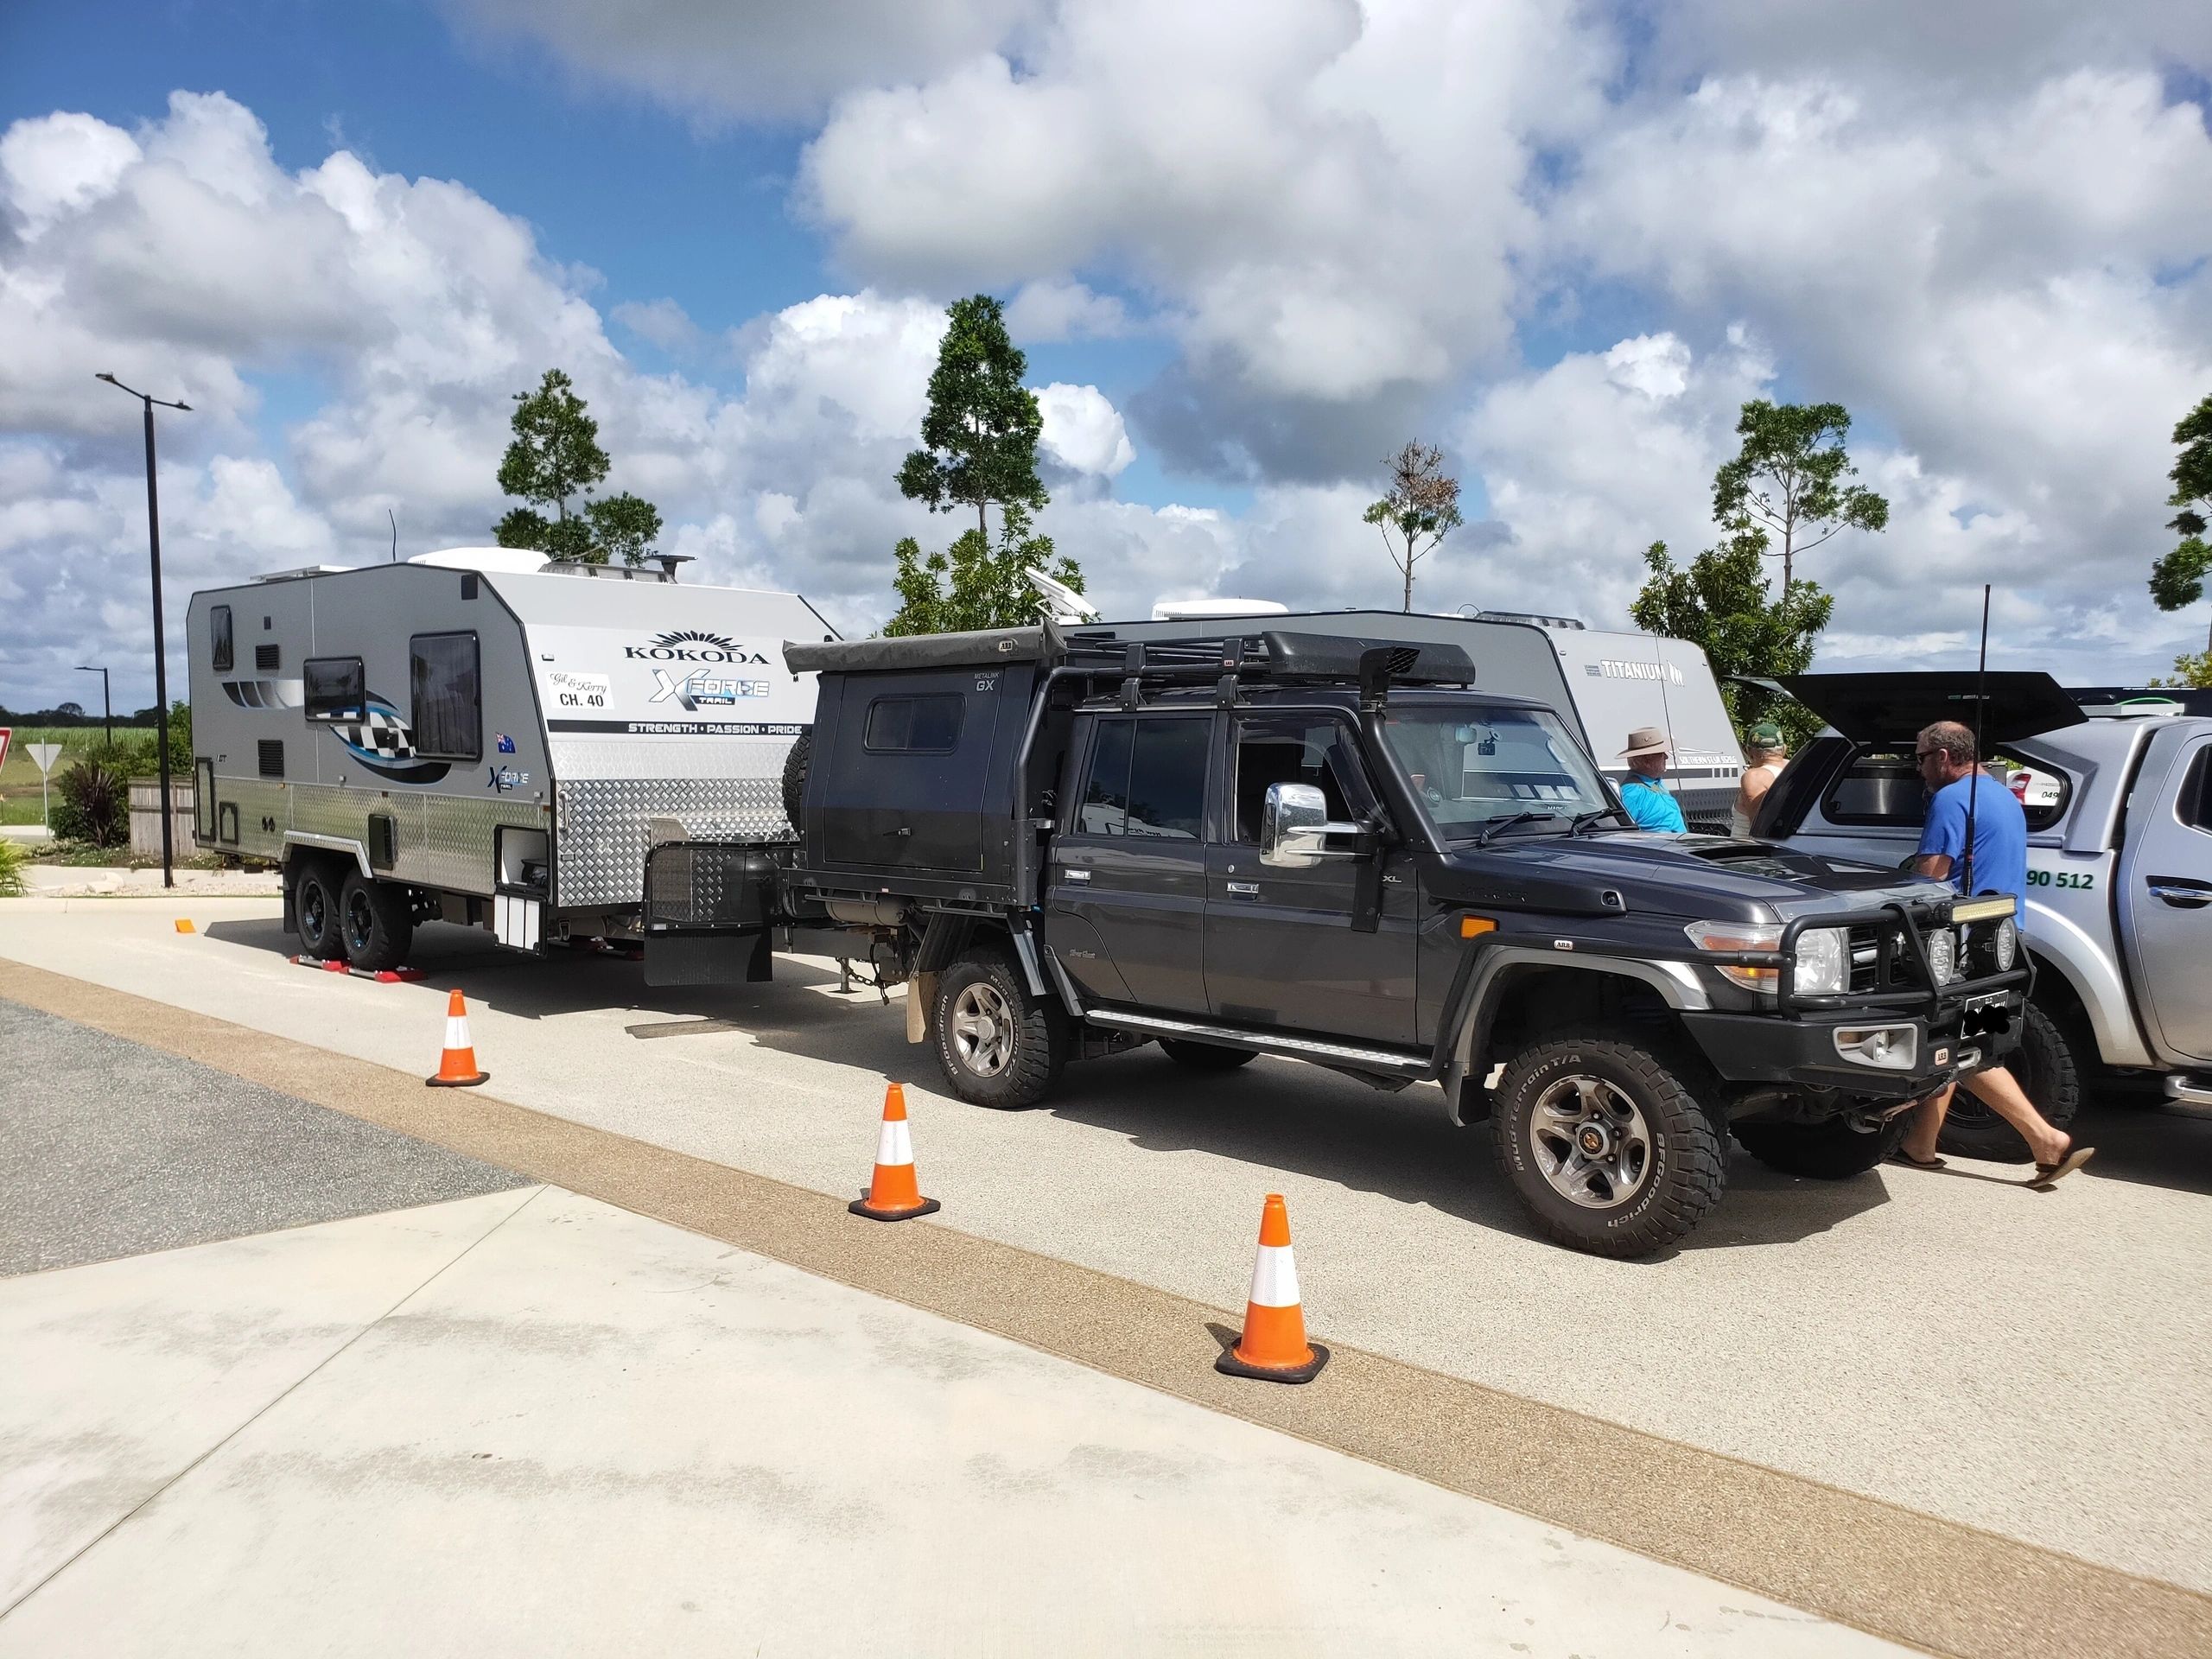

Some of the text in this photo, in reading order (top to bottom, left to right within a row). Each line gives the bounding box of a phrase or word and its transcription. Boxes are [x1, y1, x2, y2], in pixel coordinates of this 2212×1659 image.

[622, 646, 772, 665] KOKODA
[974, 671, 1000, 680] METALINK
[1600, 659, 1667, 682] TITANIUM
[550, 672, 607, 695] Gil & Kerry
[976, 679, 995, 691] GX
[559, 693, 605, 708] CH. 40
[698, 696, 733, 705] TRAIL
[628, 722, 802, 734] STRENGTH PASSION PRIDE
[2055, 872, 2094, 889] 512
[938, 995, 959, 1076] BFGoodrich
[1550, 1053, 1582, 1067] T/A
[1607, 1133, 1666, 1228] BFGoodrich
